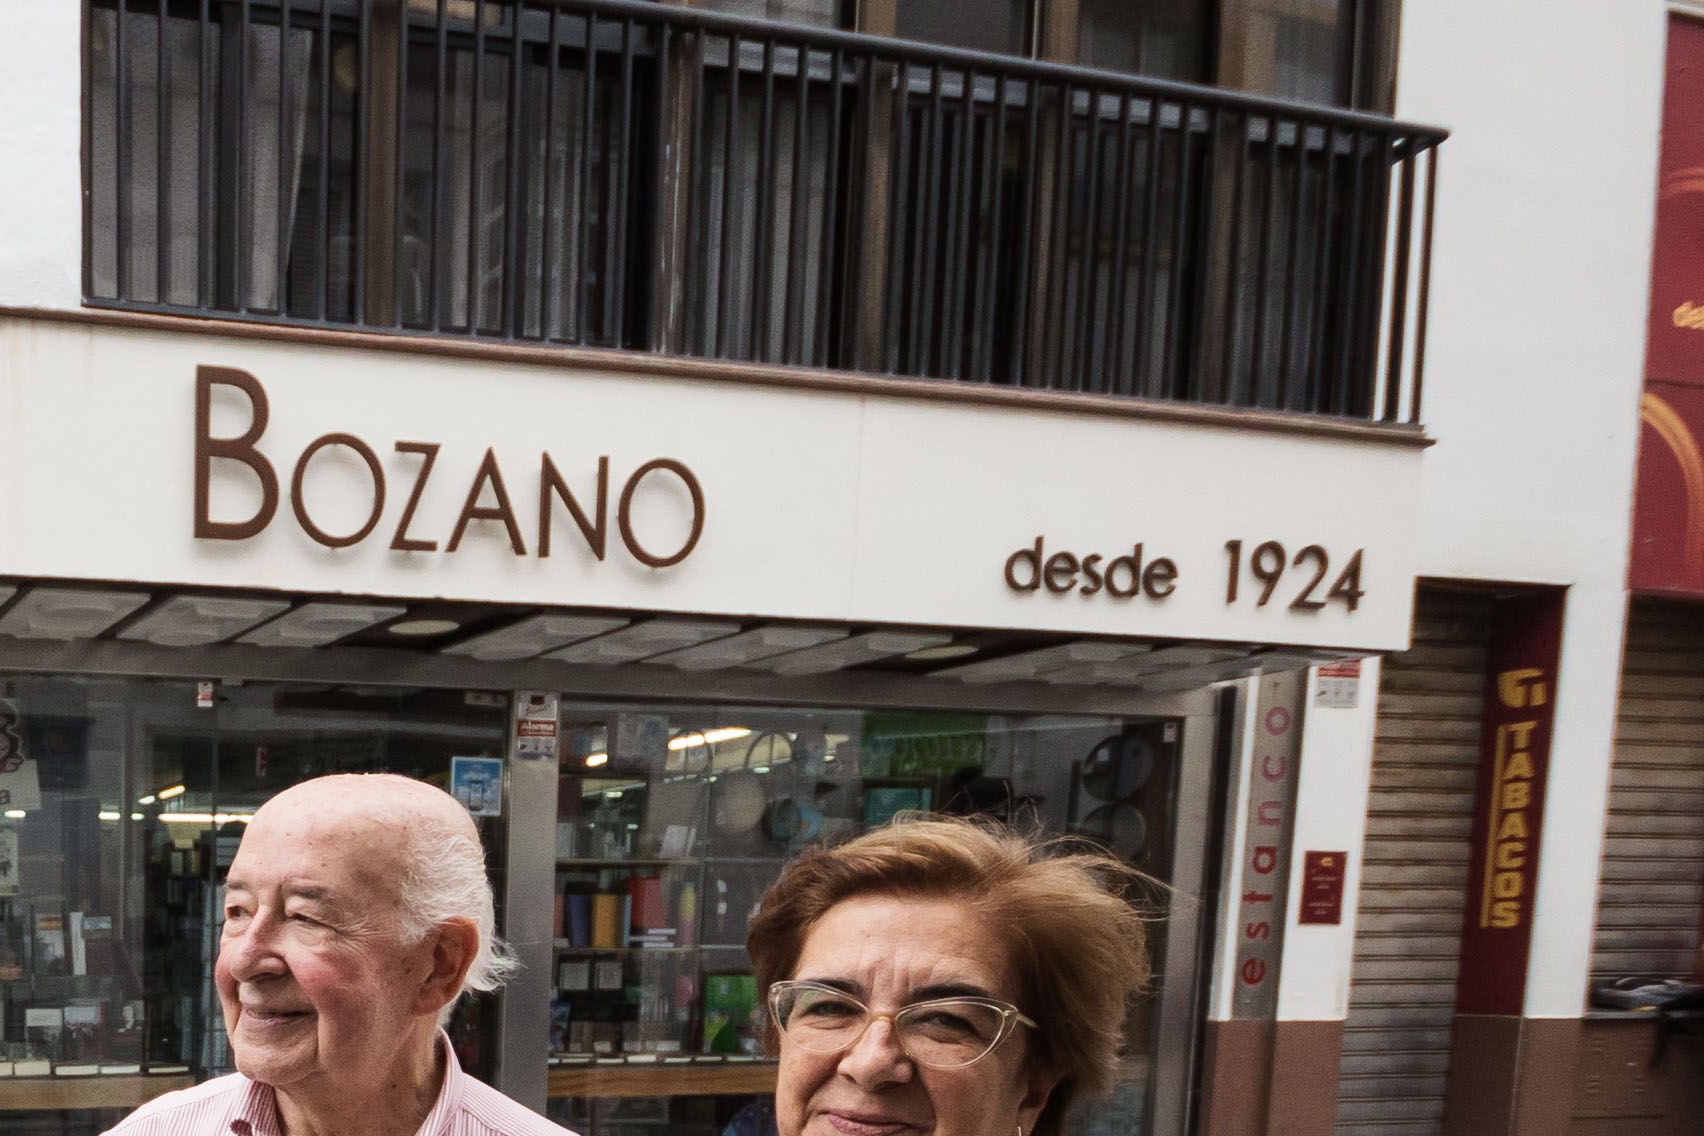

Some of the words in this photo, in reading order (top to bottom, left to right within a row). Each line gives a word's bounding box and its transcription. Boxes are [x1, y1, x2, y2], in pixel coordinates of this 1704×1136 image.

[194, 364, 705, 567] BOZANO
[1004, 535, 1178, 600] desde
[1224, 539, 1365, 613] 1924
[1241, 705, 1290, 986] estanco
[1490, 720, 1538, 928] TABACOS
